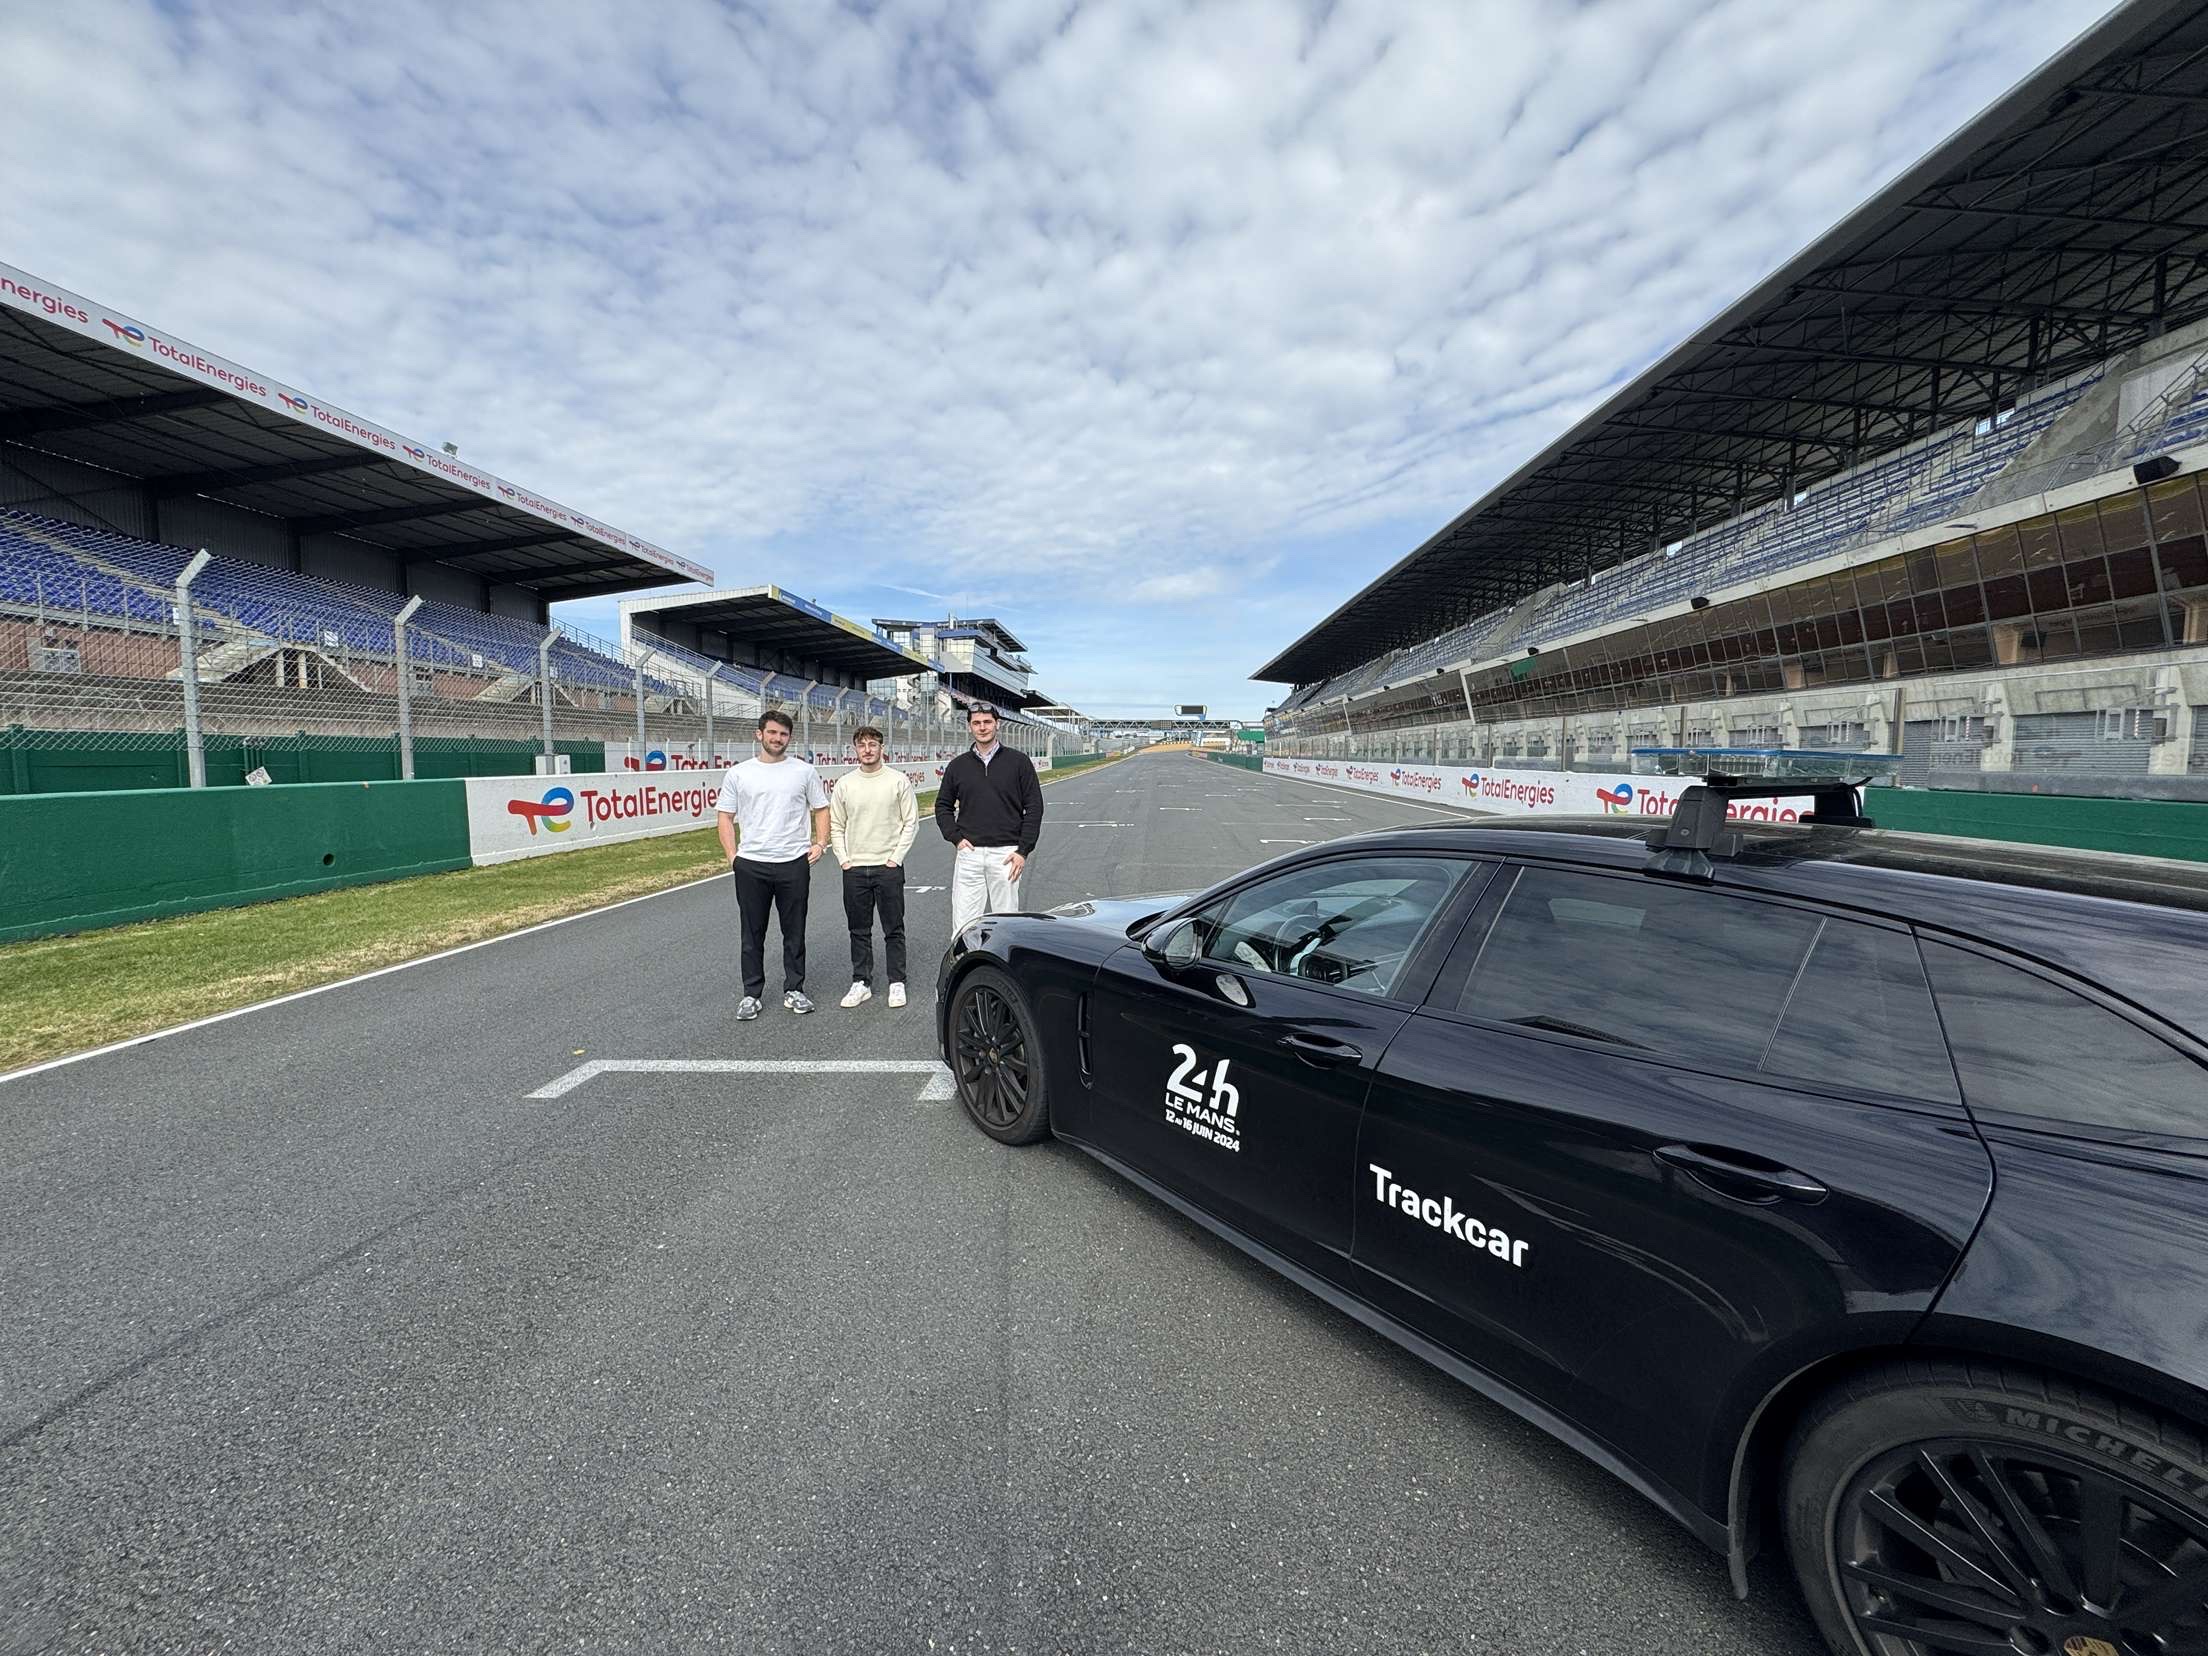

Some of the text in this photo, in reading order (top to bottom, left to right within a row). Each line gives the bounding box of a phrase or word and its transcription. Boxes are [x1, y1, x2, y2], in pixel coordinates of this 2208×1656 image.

[148, 336, 266, 397] TotalEnergies
[310, 405, 396, 450] TotalEnergies
[426, 454, 491, 489] TotalEnergies
[516, 492, 567, 520] TotalEnergies
[1402, 771, 1441, 793] TotalEnergies
[1481, 778, 1555, 808] TotalEnergies
[1165, 1092, 1184, 1112] LE
[1165, 1108, 1176, 1123] 12
[1183, 1117, 1193, 1132] 16
[1192, 1122, 1214, 1141] JUIN
[1213, 1131, 1240, 1153] 2024
[1369, 1163, 1529, 1268] Trackcar
